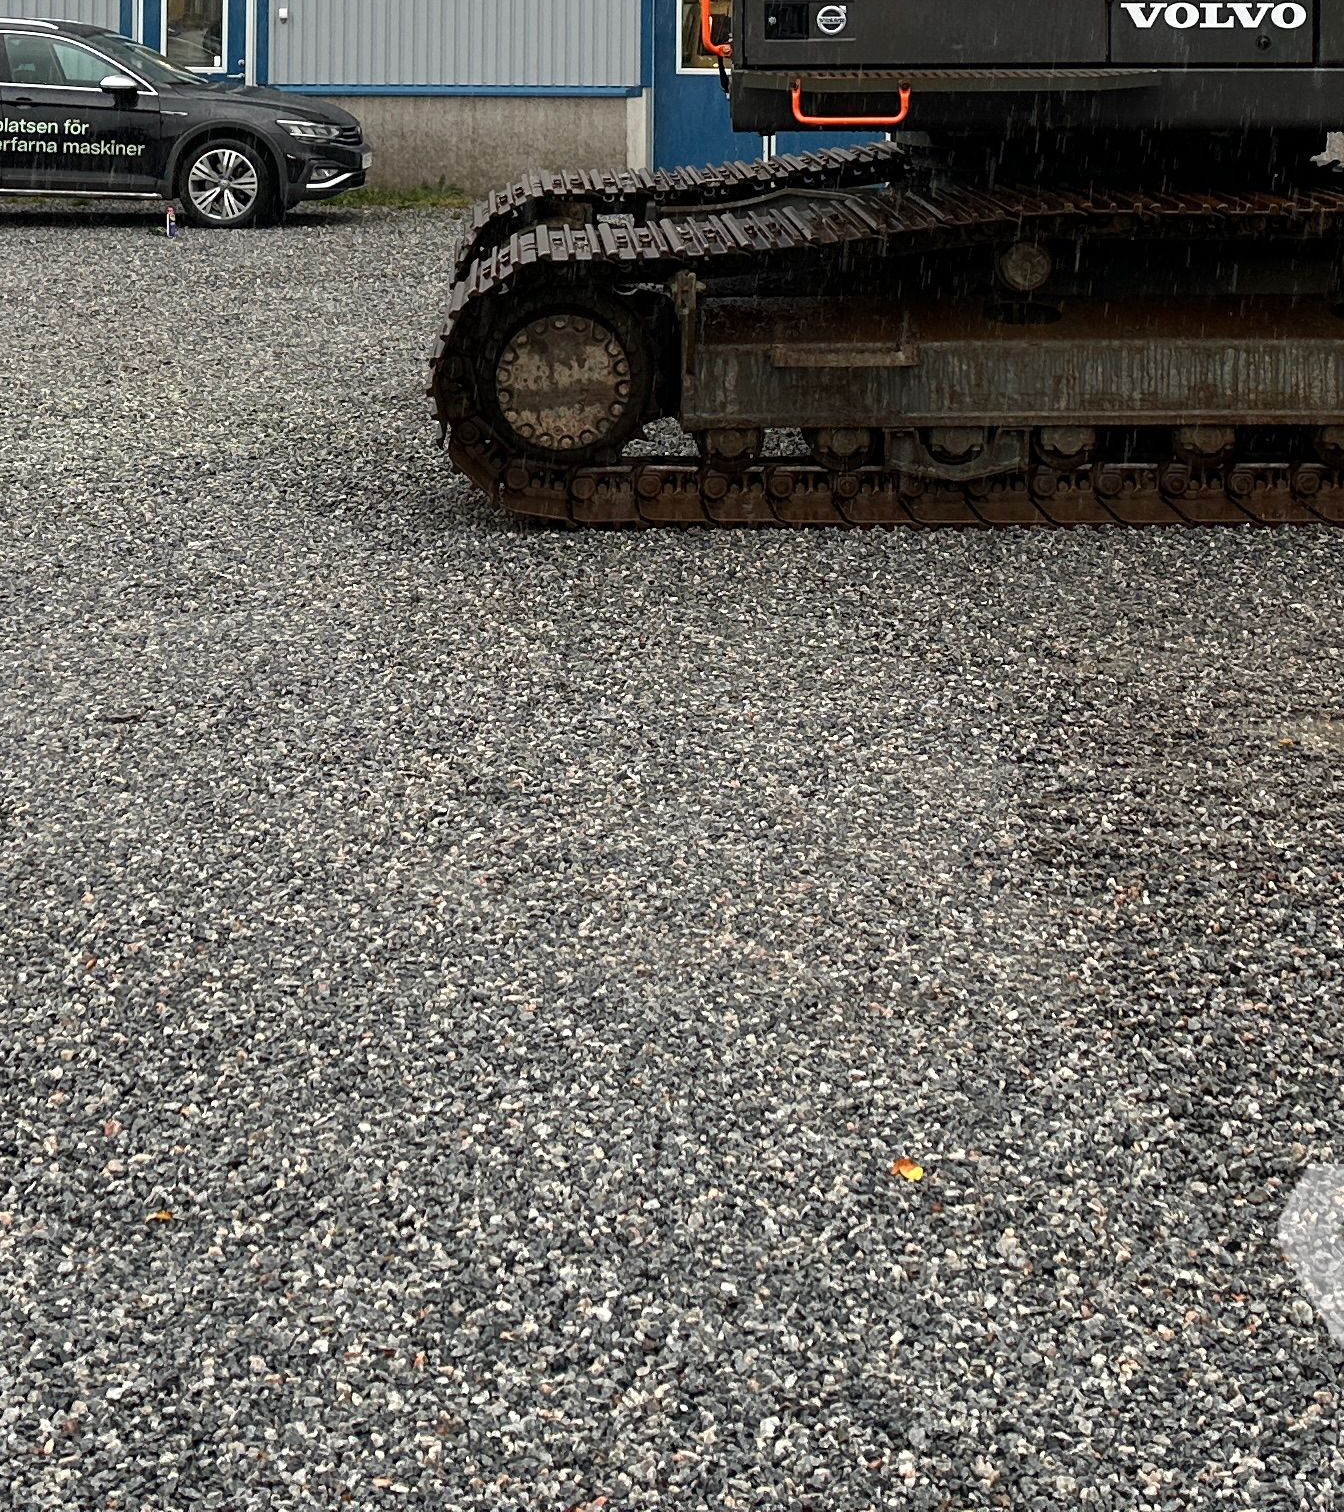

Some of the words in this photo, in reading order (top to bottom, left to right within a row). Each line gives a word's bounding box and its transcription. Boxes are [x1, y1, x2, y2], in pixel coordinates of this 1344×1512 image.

[1120, 2, 1307, 29] VOLVO
[63, 118, 90, 136] för
[62, 139, 146, 157] maskiner
